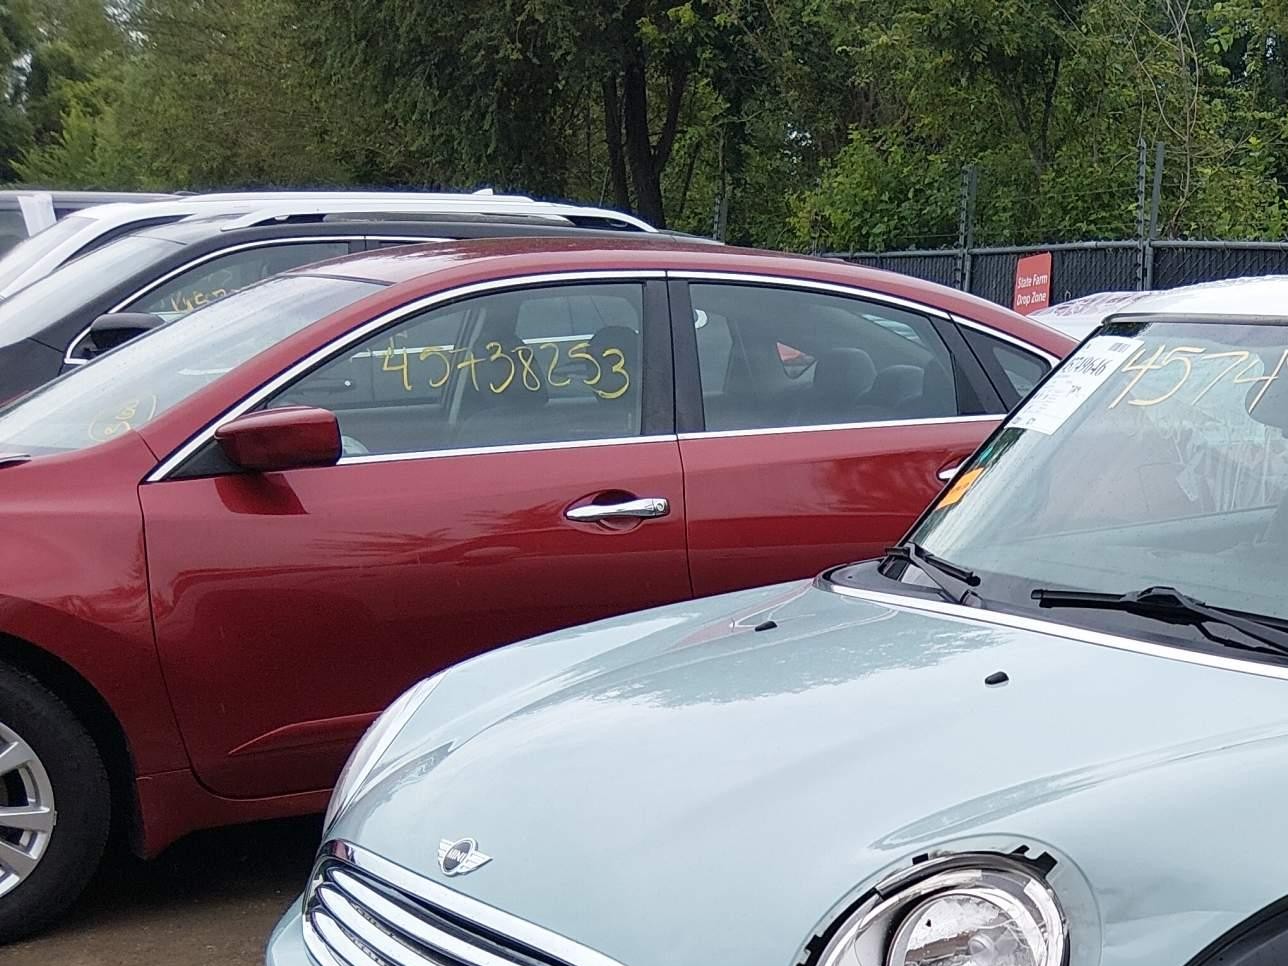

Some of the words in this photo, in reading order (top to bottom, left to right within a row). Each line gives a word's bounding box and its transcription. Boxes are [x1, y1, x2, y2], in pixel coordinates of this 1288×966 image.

[1018, 276, 1031, 288] State
[1033, 274, 1047, 286] Farm
[1017, 294, 1030, 307] Drop
[1031, 292, 1046, 304] Zone
